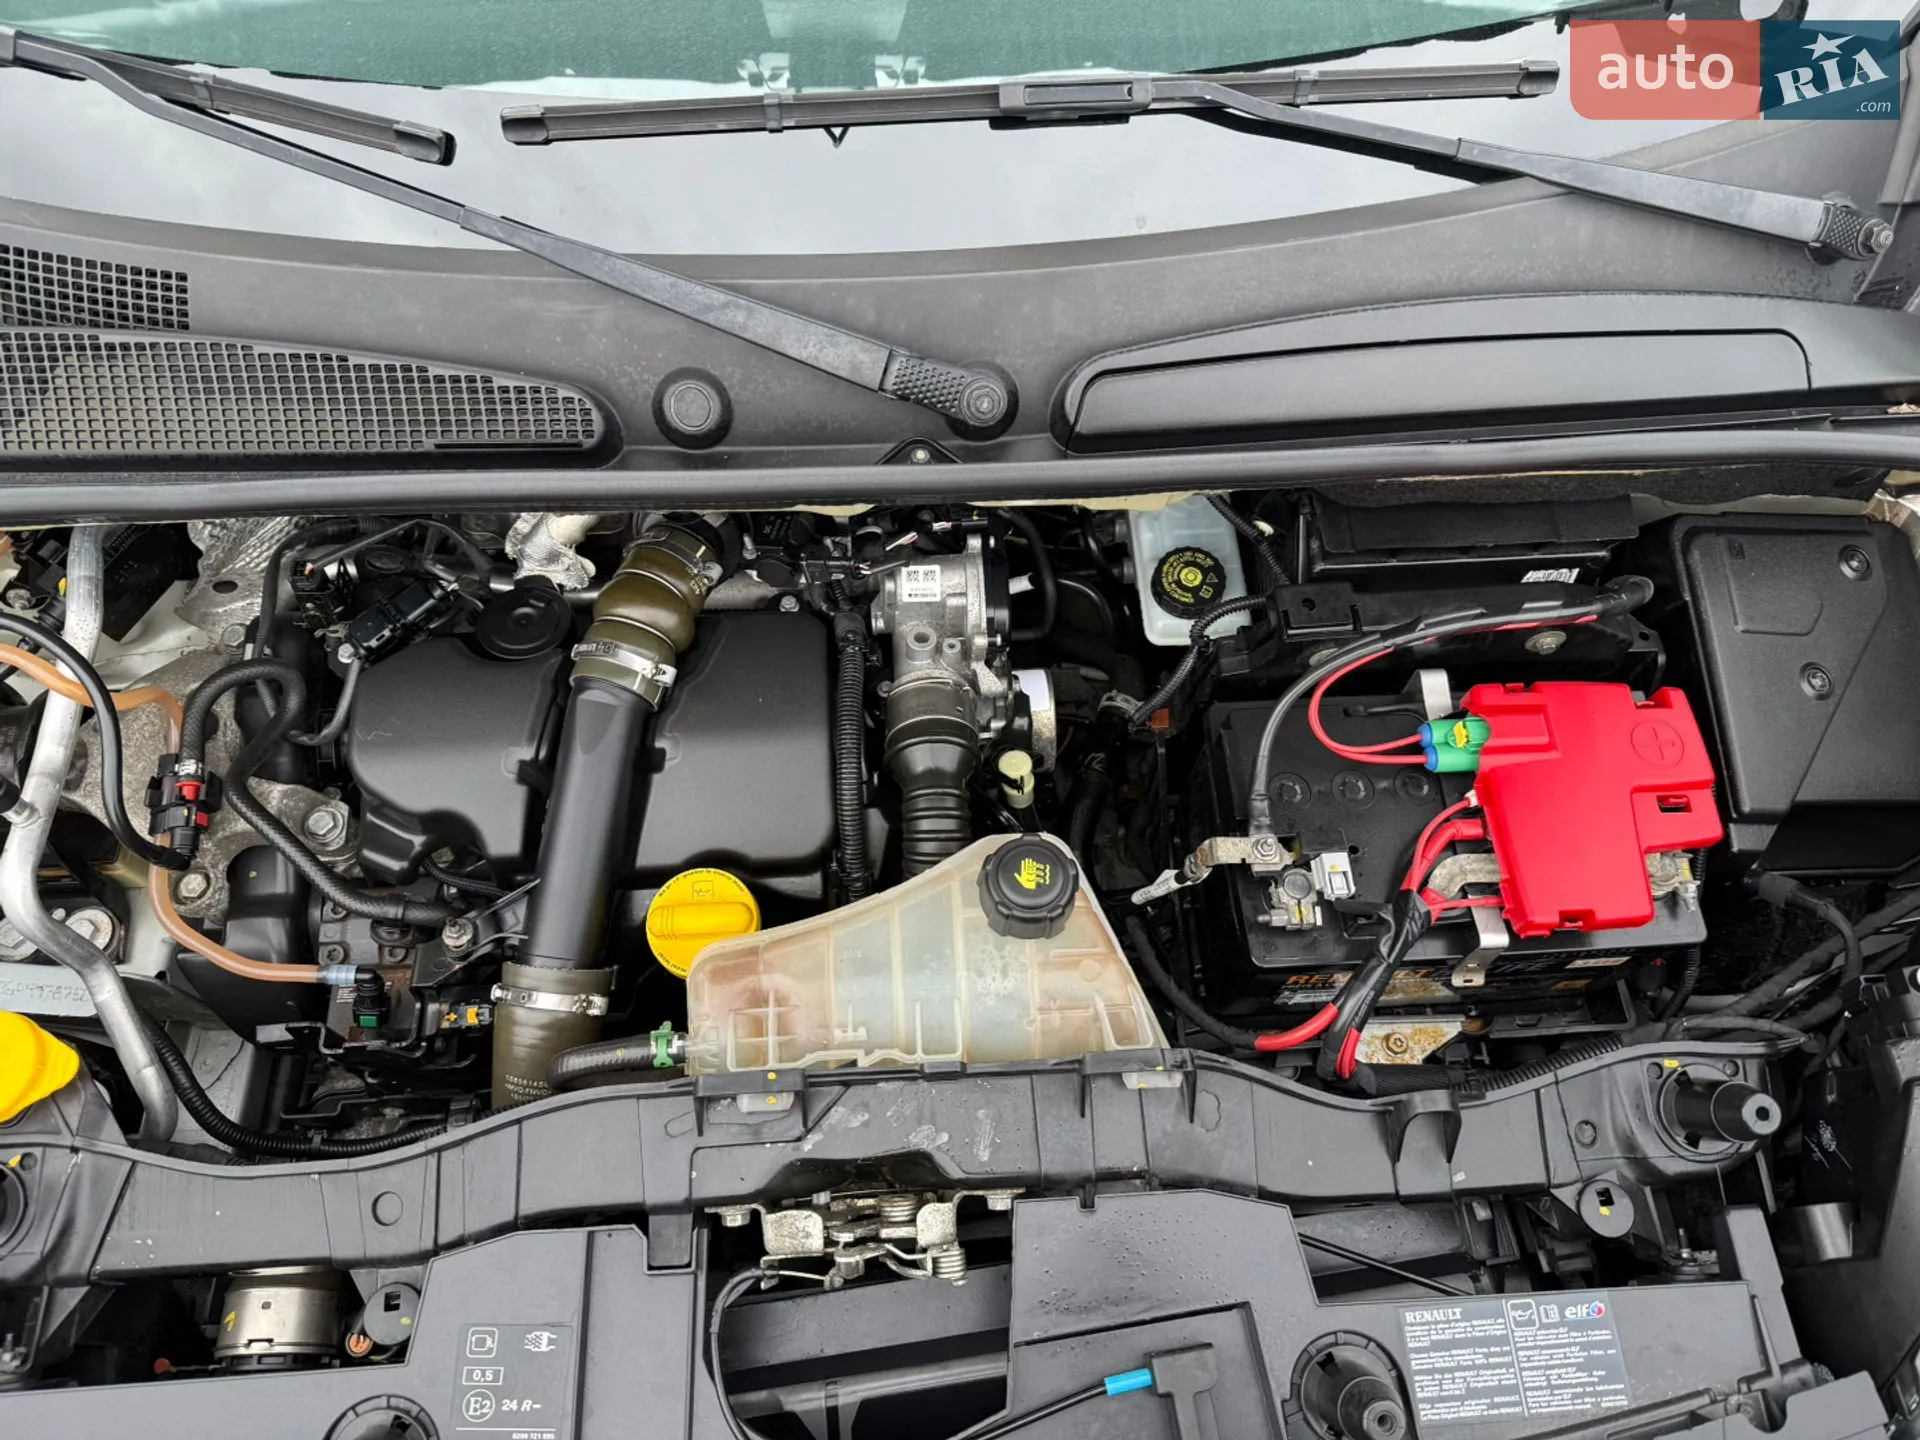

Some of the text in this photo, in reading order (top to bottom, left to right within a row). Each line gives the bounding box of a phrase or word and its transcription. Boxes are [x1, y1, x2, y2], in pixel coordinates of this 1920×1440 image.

[1405, 1308, 1462, 1323] RENAULT
[1564, 1304, 1589, 1318] elf
[473, 1370, 493, 1382] 0,5
[468, 1397, 491, 1416] E2
[501, 1400, 518, 1411] 24
